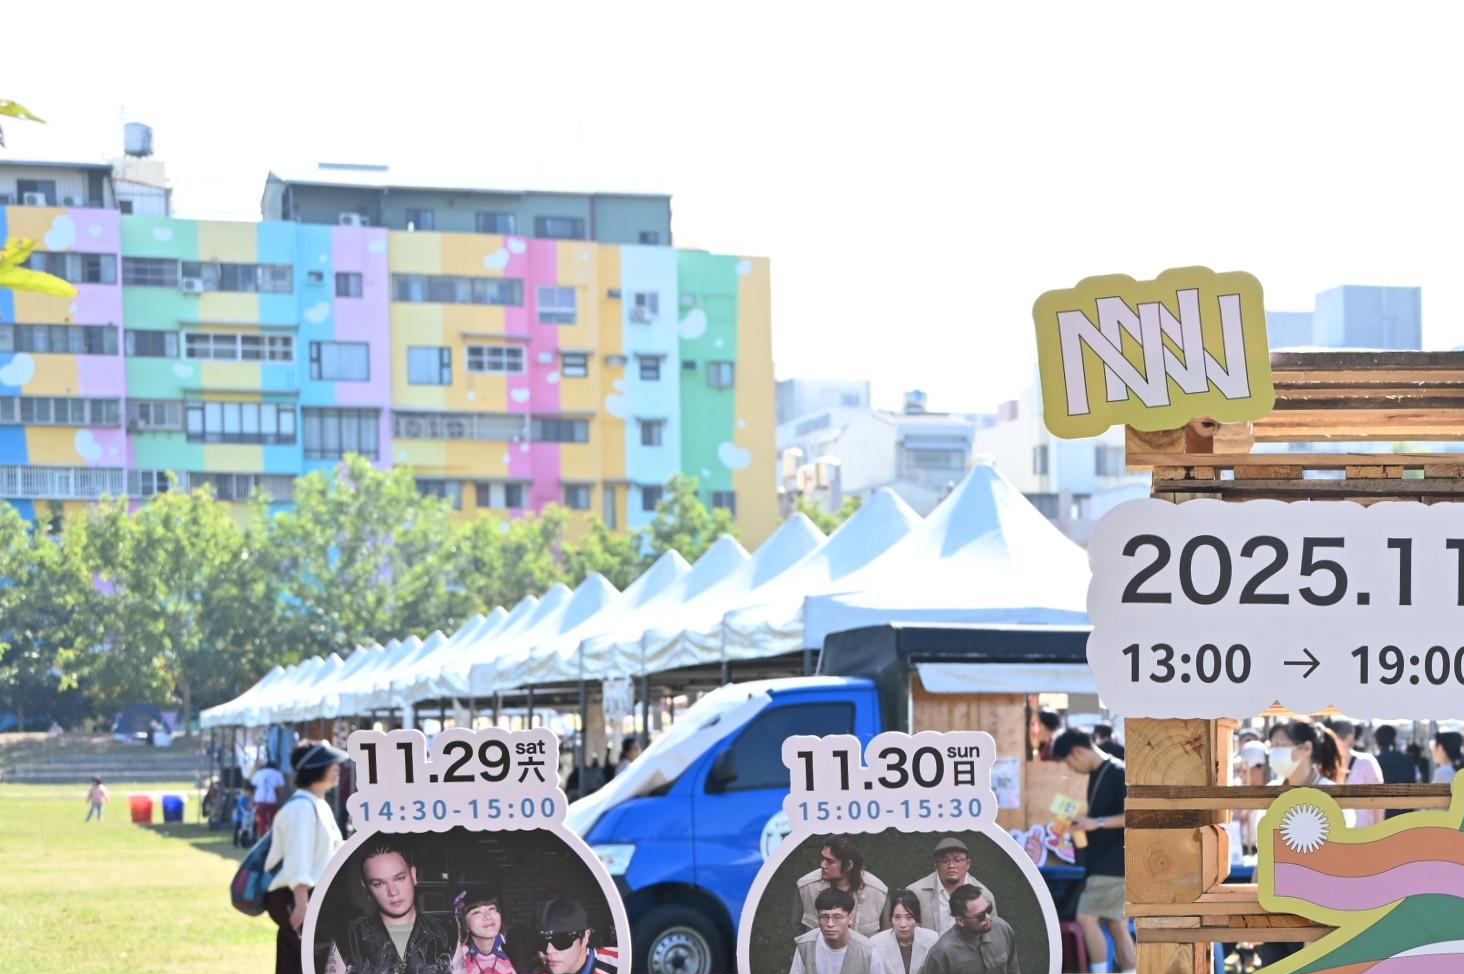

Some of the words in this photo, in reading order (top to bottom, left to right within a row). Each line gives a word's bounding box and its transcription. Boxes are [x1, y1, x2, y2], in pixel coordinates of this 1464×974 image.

[1122, 643, 1252, 684] 13:00
[360, 739, 511, 785] 11.29
[515, 739, 546, 755] sat
[517, 756, 546, 784] 六
[798, 744, 945, 792] 11.30
[946, 746, 980, 760] sun
[953, 760, 976, 787] 日
[360, 797, 555, 822] 14:30-15:00
[799, 798, 982, 822] 15:00-15:30
